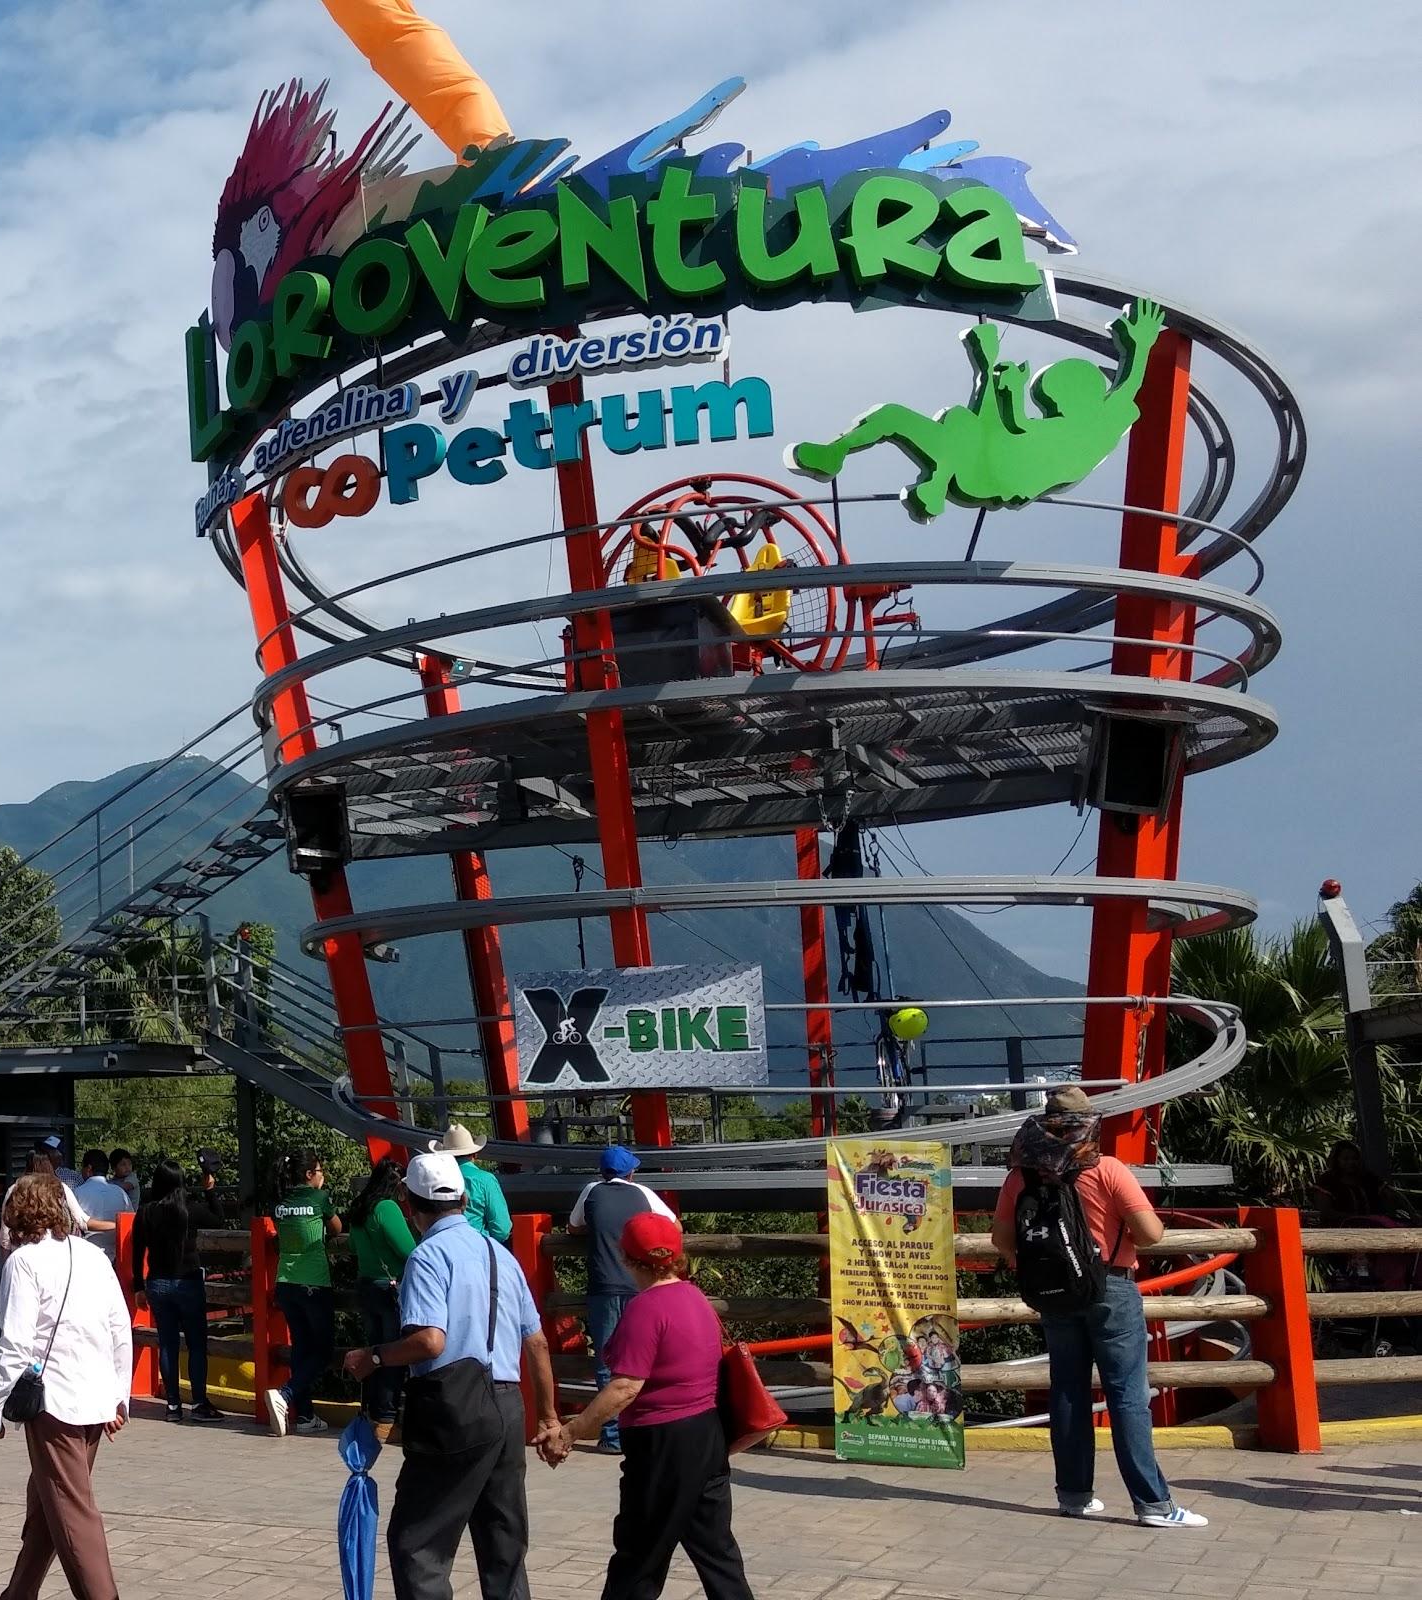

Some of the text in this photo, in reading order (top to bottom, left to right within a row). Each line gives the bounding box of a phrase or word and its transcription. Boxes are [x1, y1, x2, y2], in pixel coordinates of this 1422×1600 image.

[253, 381, 408, 472] adrenalina
[439, 372, 469, 420] y
[511, 315, 724, 380] diversión
[383, 376, 775, 505] Petrum
[521, 987, 760, 1085] X-BIKE
[855, 1173, 926, 1199] Fiesta
[274, 1204, 315, 1220] Corona
[851, 1239, 934, 1250] ACCESO AL PARQUE
[858, 1249, 931, 1260] Y SHOW DE AVES
[1058, 1217, 1083, 1278] UNDER ARMOUR
[892, 1272, 906, 1280] DOG
[897, 1290, 929, 1300] PASTEL
